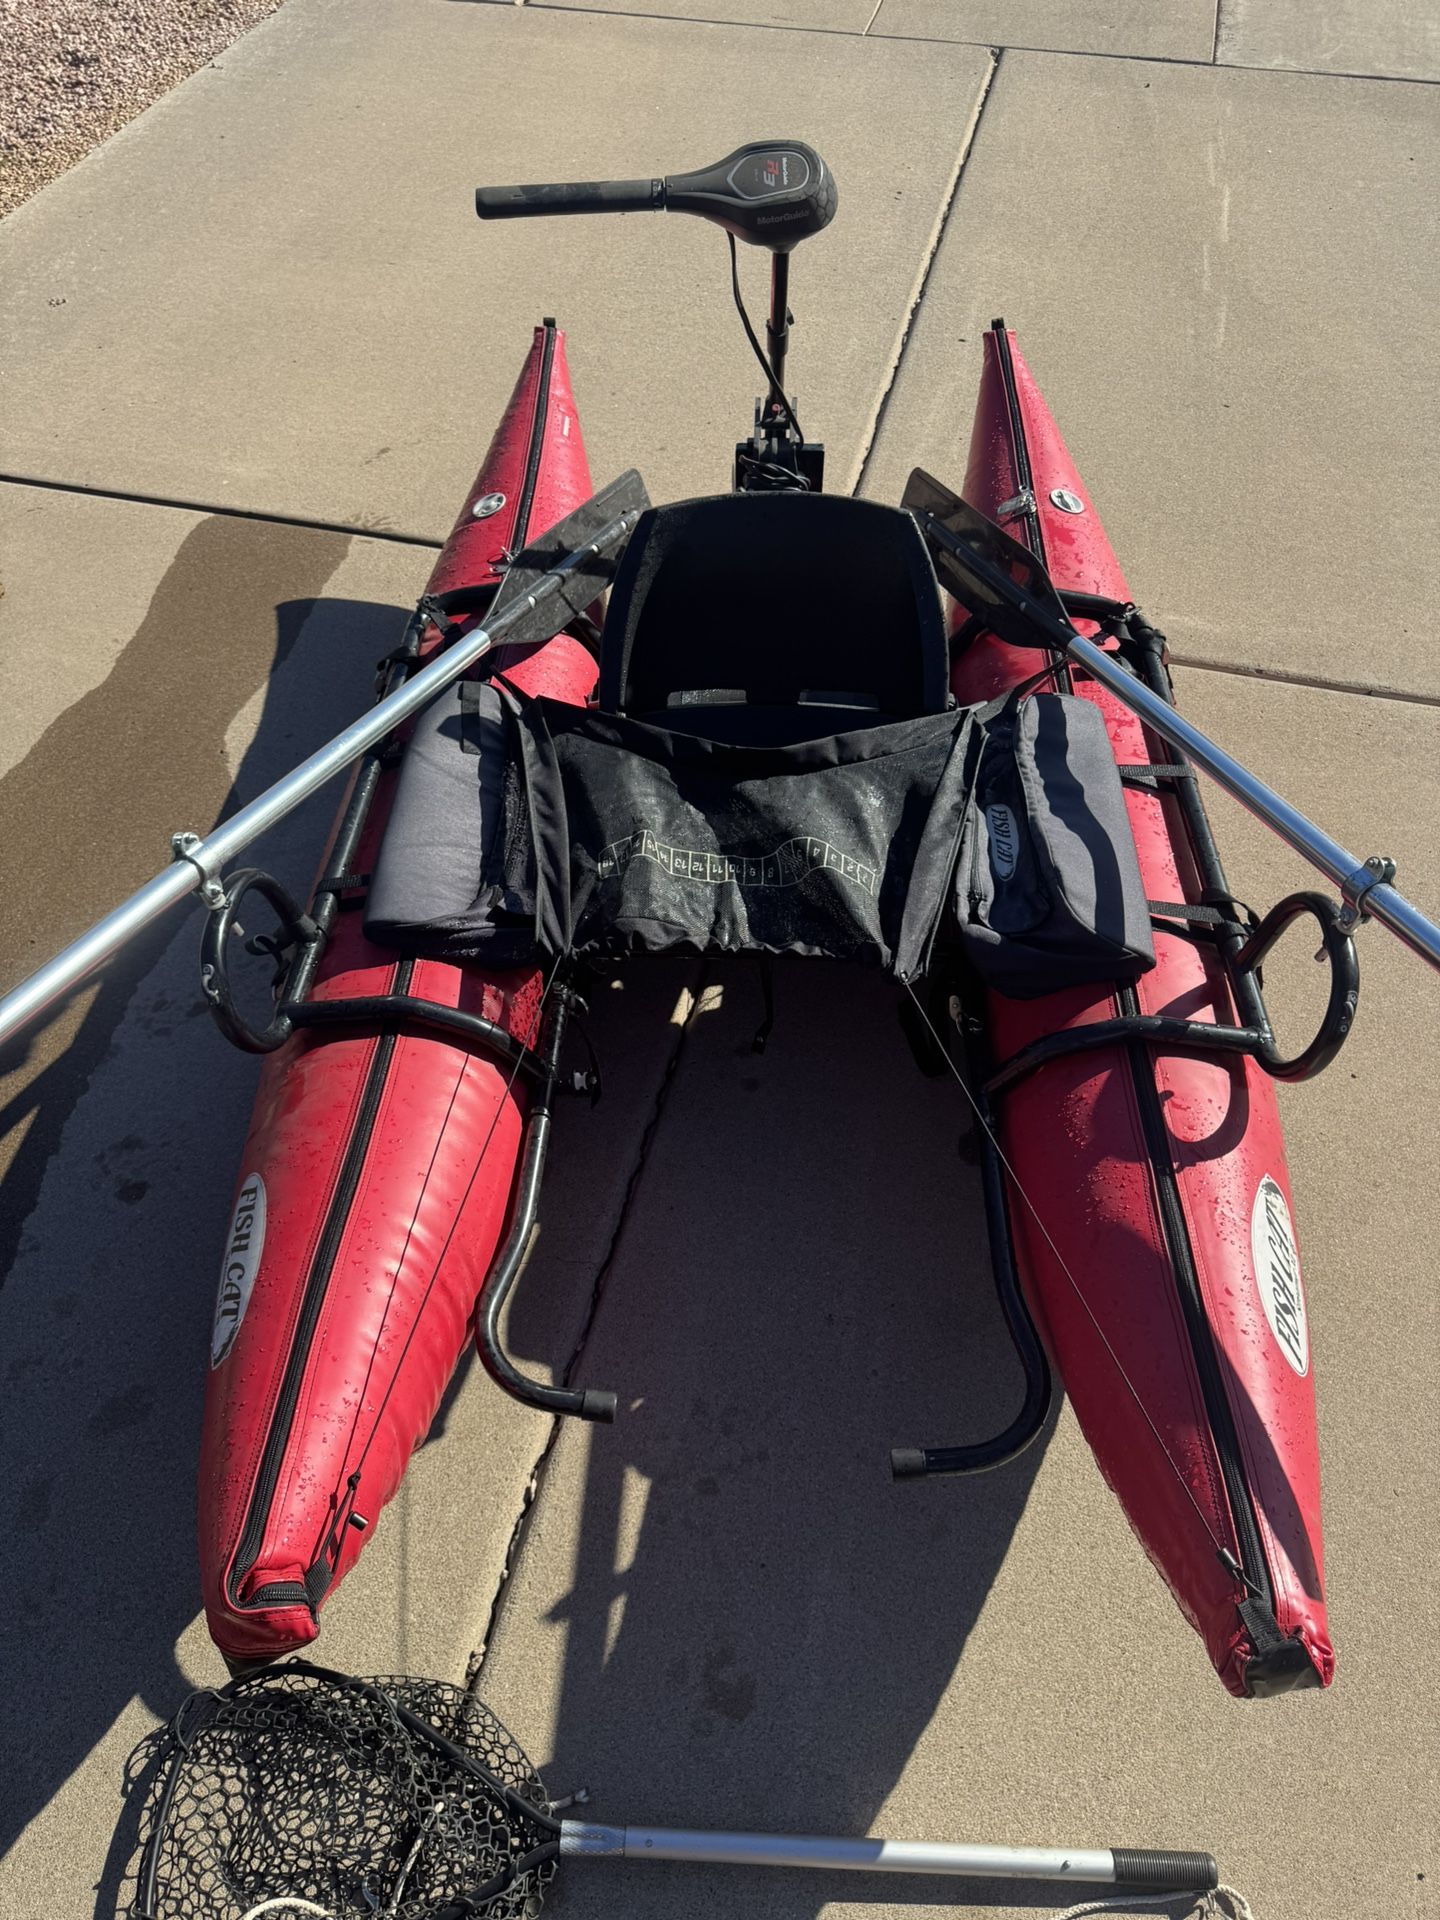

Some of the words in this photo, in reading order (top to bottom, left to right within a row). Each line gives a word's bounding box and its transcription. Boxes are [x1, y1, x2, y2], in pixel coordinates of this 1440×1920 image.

[991, 807, 1011, 838] FISH
[674, 858, 687, 869] 13
[996, 839, 1013, 864] CAT
[692, 861, 704, 872] 12
[712, 863, 723, 874] 11
[729, 863, 741, 874] 10
[230, 1185, 258, 1255] FISH
[1264, 1197, 1294, 1283] CAT
[220, 1262, 246, 1323] CAT
[1270, 1261, 1304, 1371] FISH
